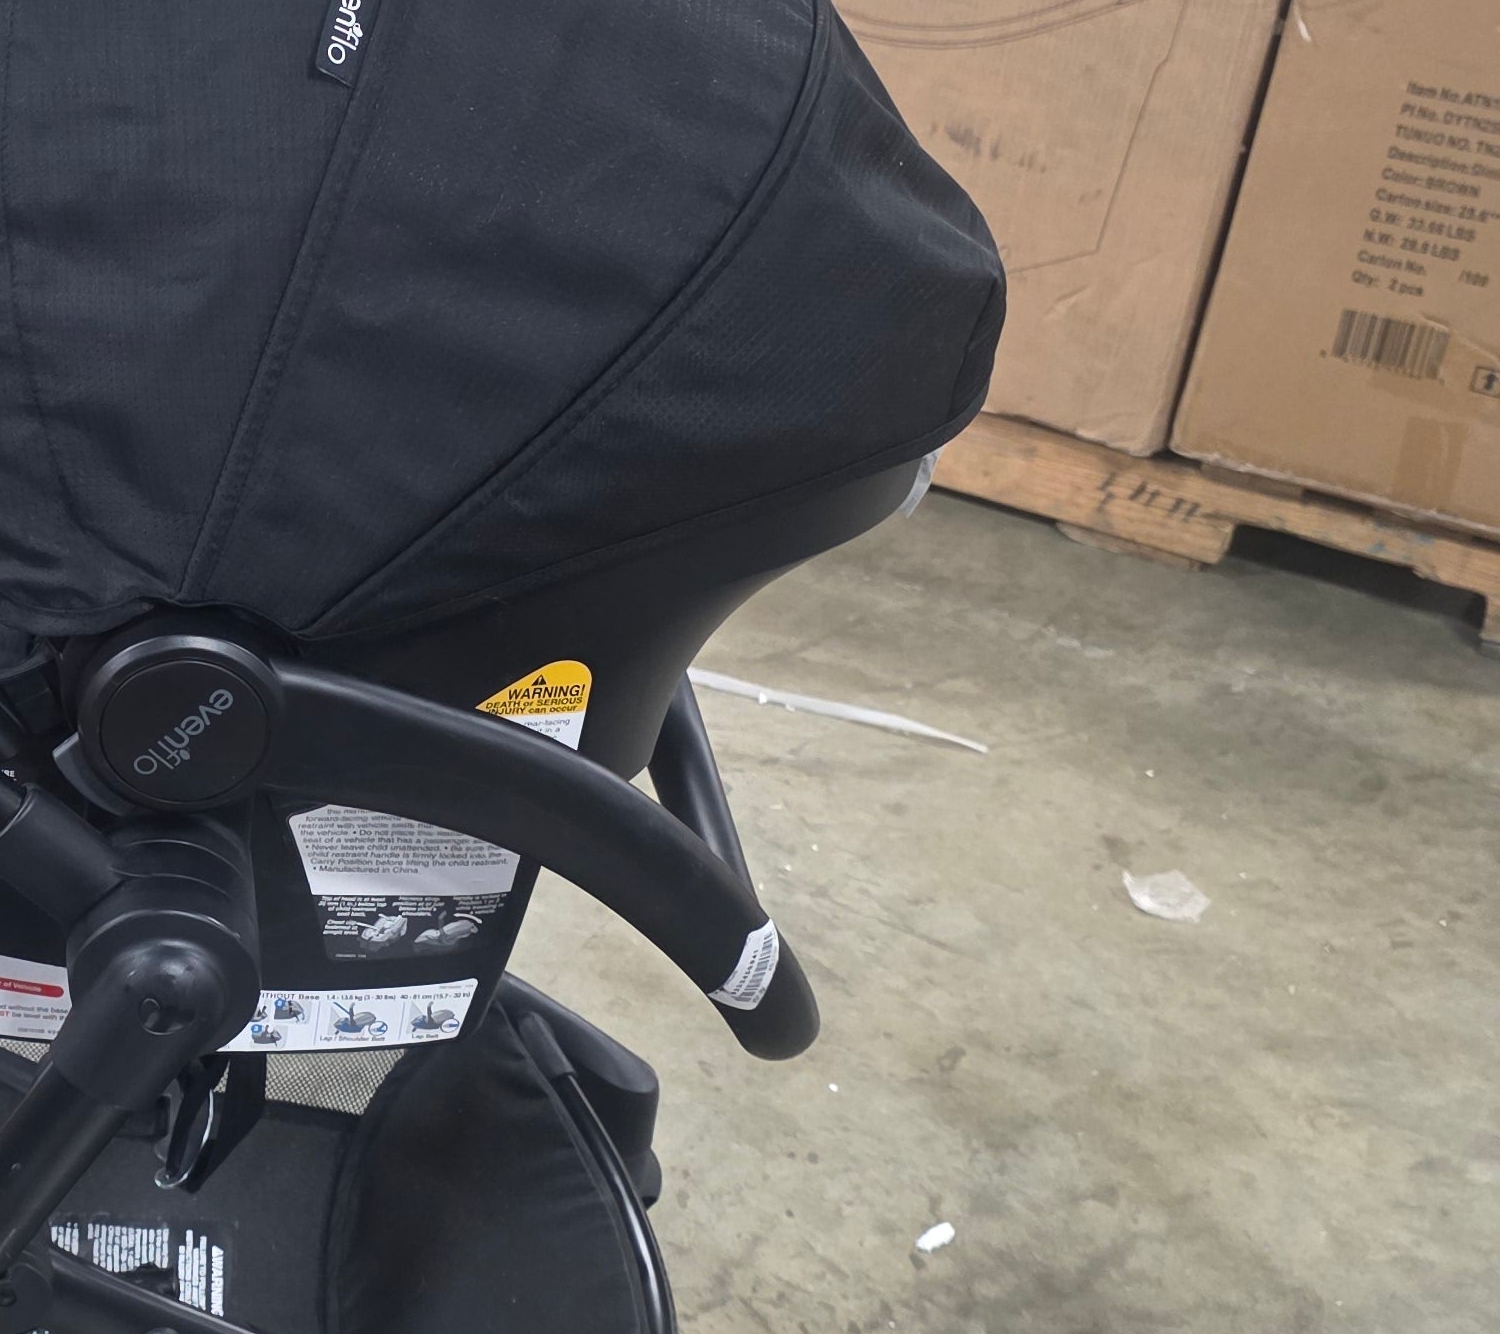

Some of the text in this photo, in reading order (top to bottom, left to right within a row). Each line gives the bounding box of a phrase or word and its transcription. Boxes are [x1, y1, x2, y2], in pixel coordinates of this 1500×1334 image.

[508, 684, 586, 701] WARNING!
[486, 700, 521, 709] DEATH
[536, 696, 583, 706] SERIOUS
[488, 707, 526, 715] INJURY
[549, 705, 578, 713] occur
[133, 689, 235, 776] evenflo
